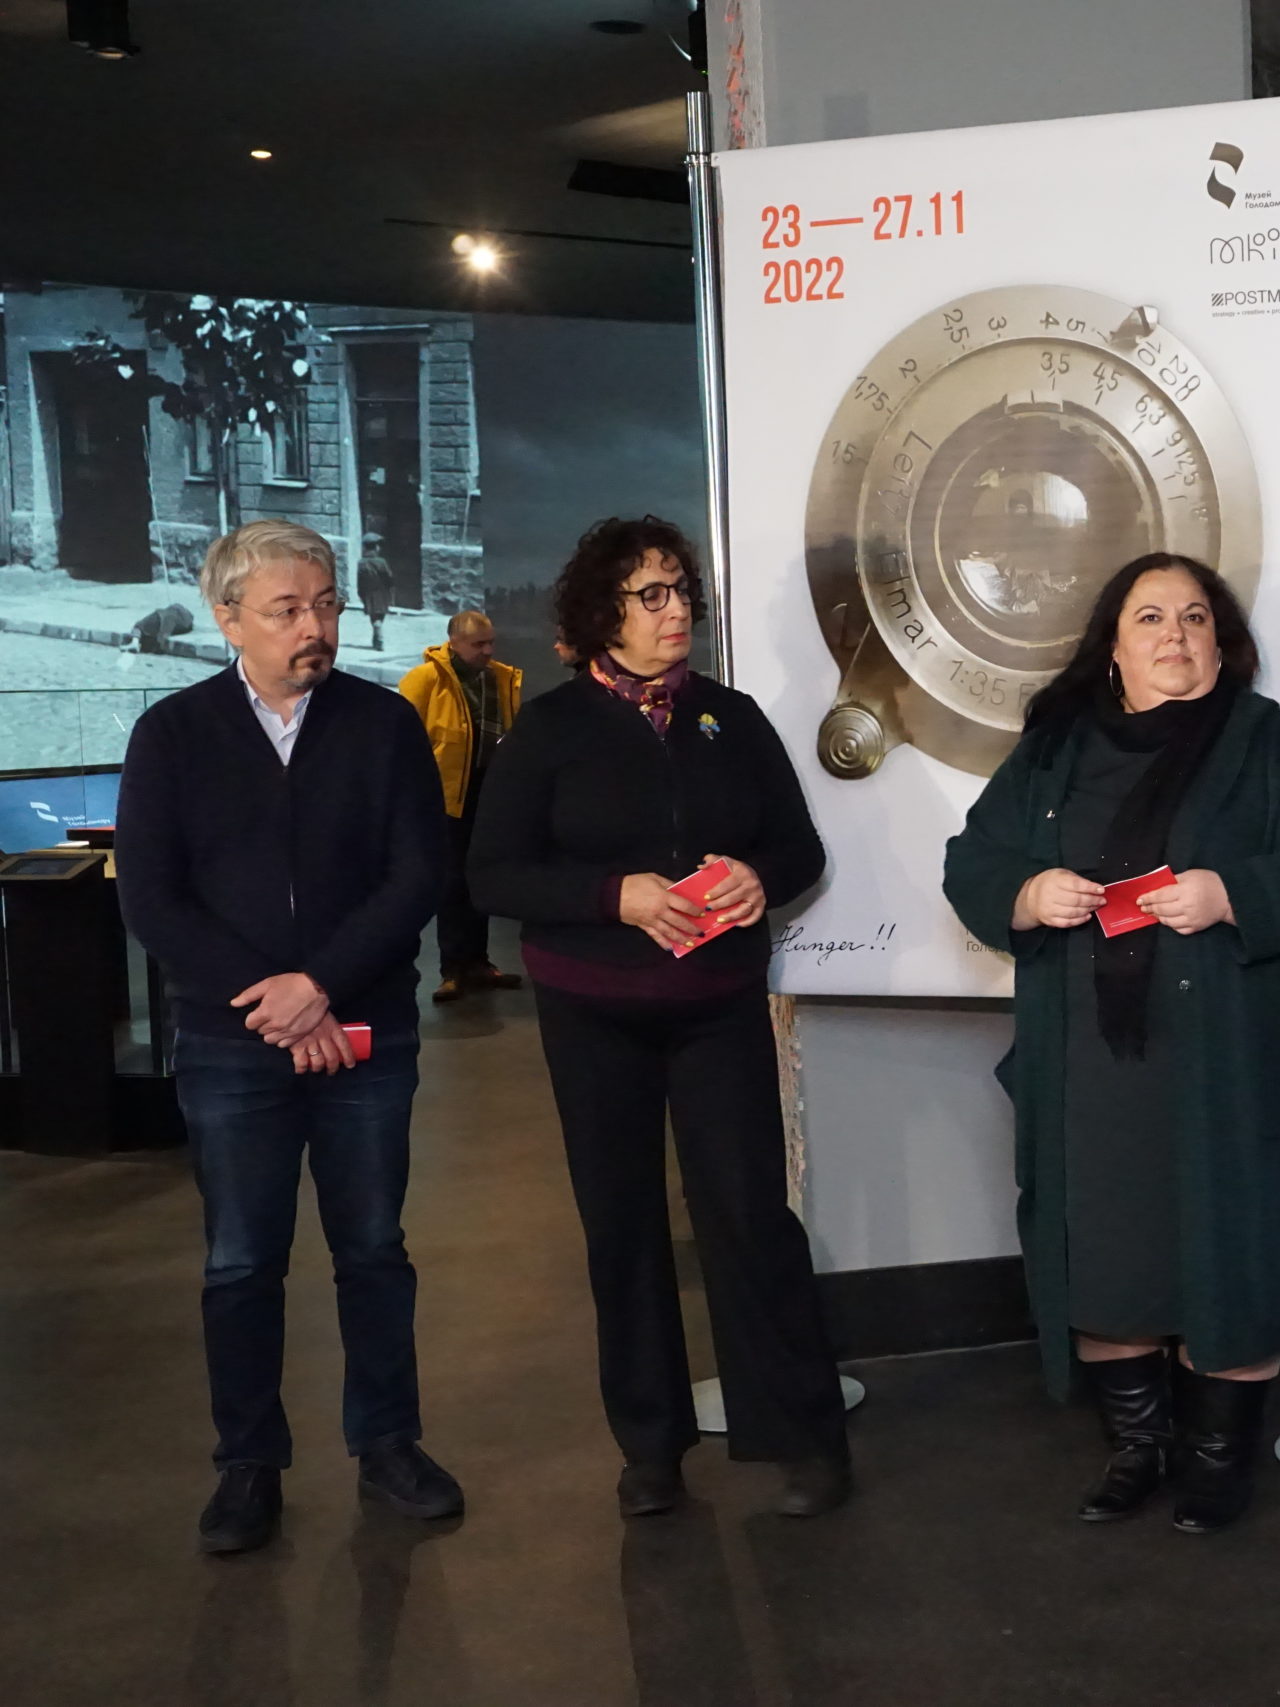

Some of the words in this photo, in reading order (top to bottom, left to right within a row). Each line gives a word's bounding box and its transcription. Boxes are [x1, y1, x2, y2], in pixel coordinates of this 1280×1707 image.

[1245, 190, 1271, 200] Музей
[761, 204, 801, 249] 23
[873, 190, 964, 240] 27.11
[763, 256, 844, 304] 2022
[988, 316, 1007, 331] 3
[1040, 311, 1060, 329] 4
[1066, 318, 1086, 333] 5
[773, 925, 866, 966] Hunger
